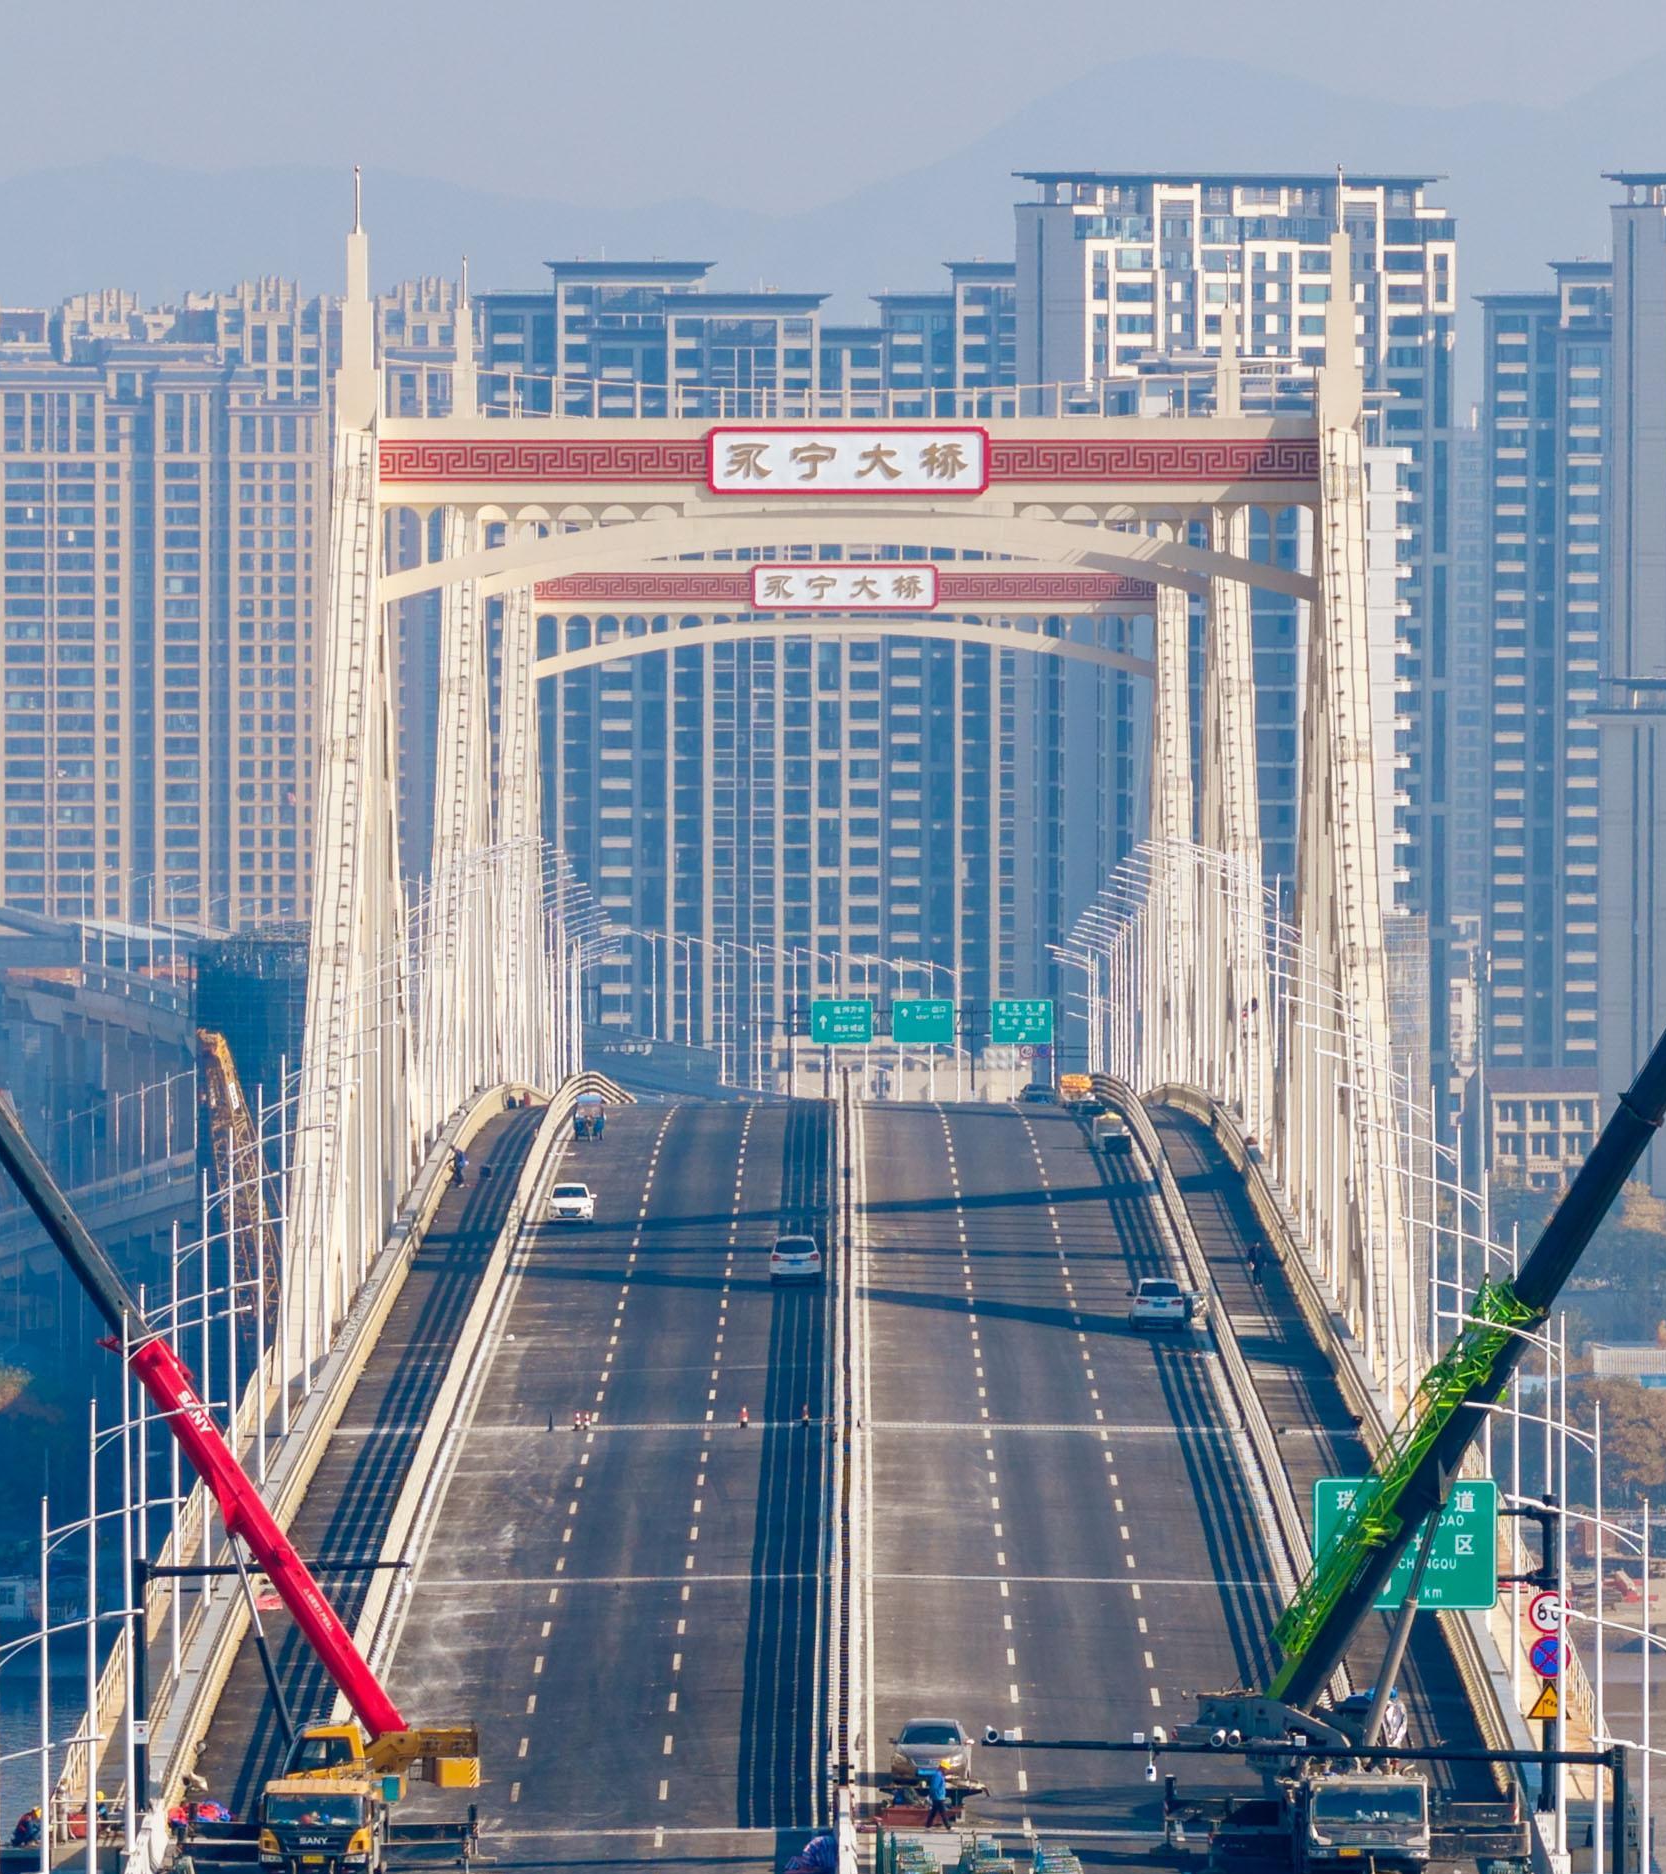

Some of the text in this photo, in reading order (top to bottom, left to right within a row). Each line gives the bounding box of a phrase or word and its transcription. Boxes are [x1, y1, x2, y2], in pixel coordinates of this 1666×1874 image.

[724, 440, 968, 482] 永宁大桥
[764, 573, 931, 602] 永宁大桥
[1398, 1557, 1457, 1570] CHNGQU
[1424, 1586, 1443, 1599] km
[299, 1837, 328, 1845] SANY
